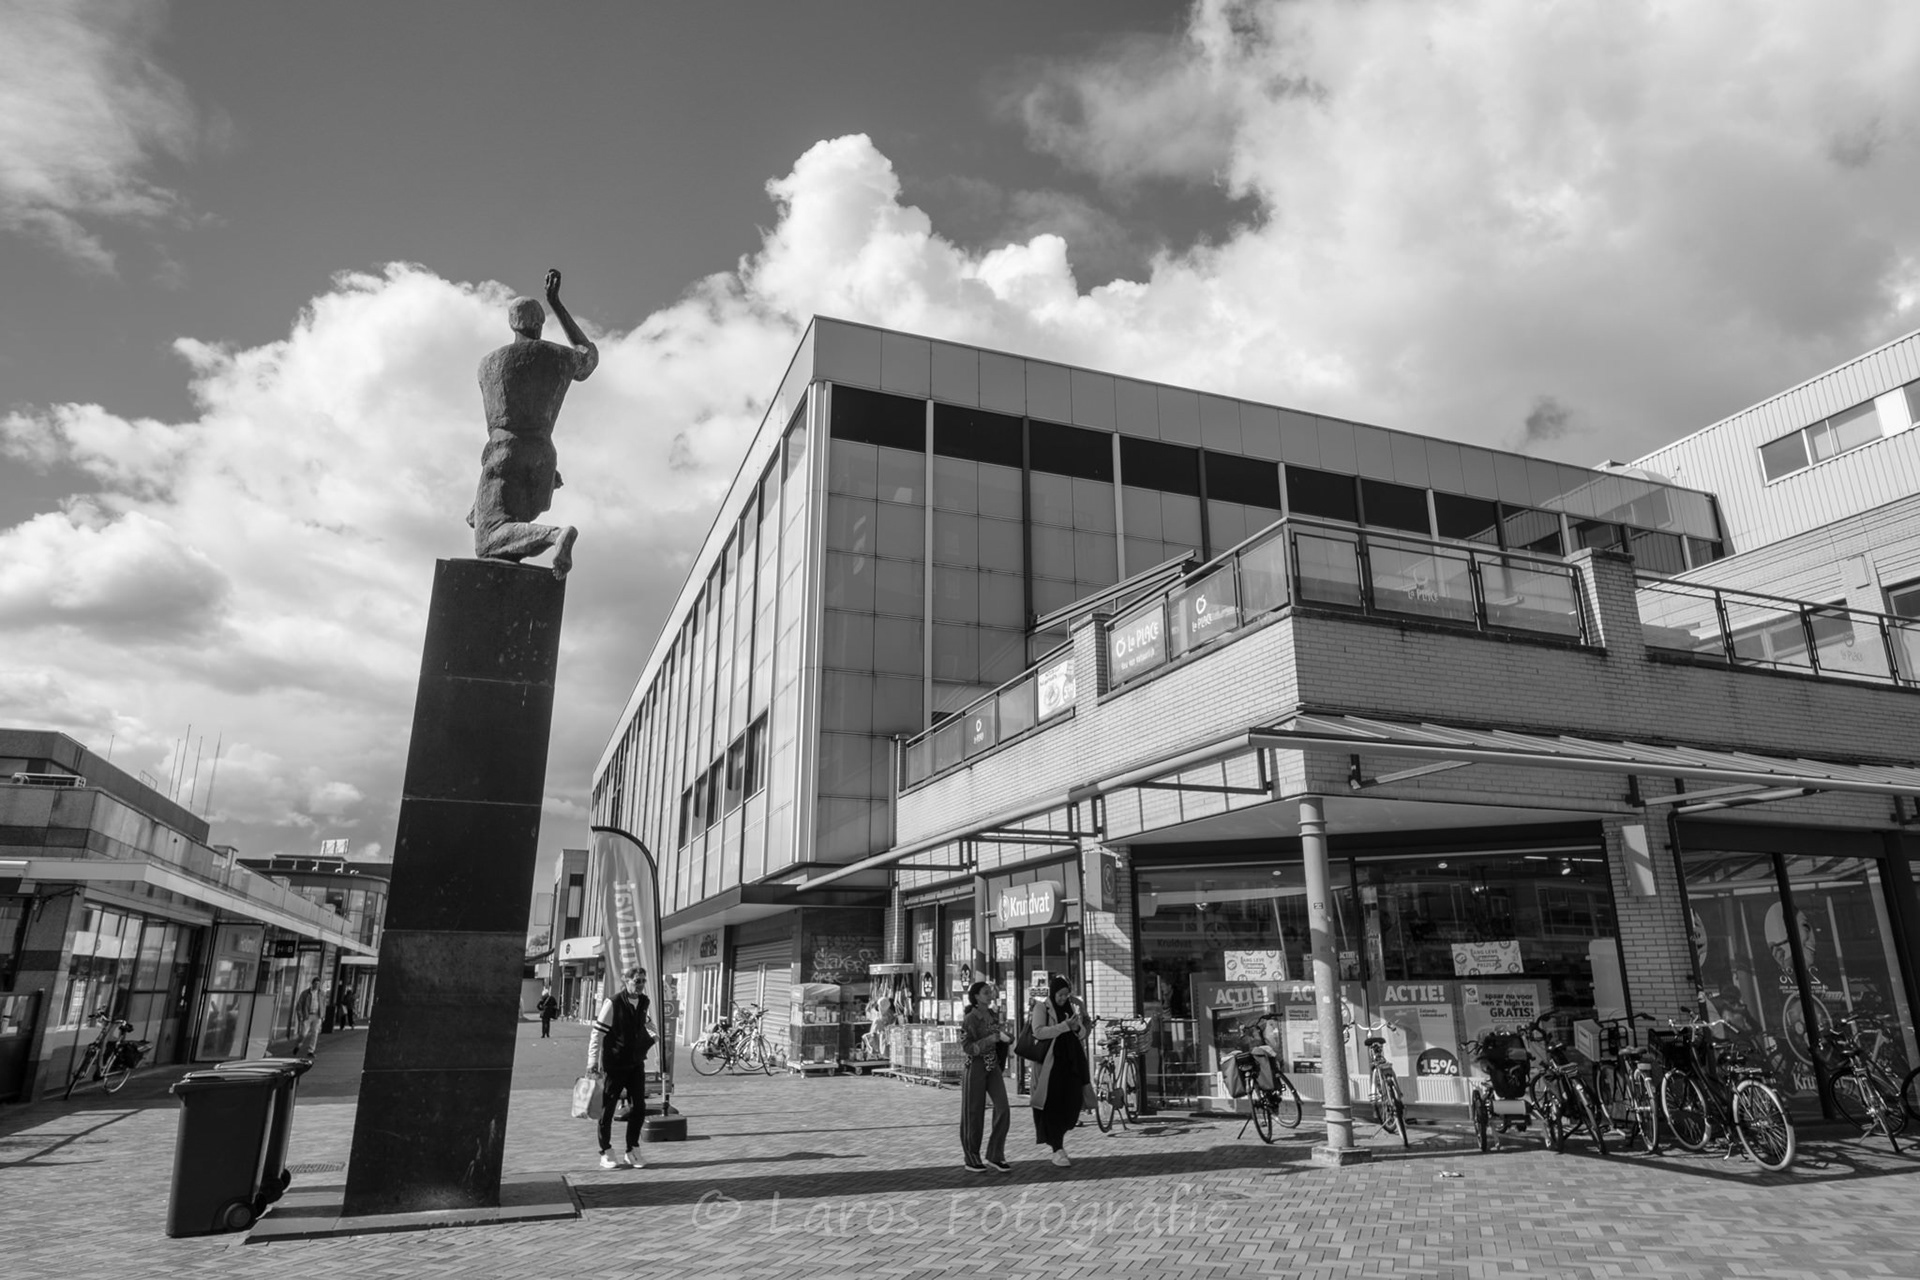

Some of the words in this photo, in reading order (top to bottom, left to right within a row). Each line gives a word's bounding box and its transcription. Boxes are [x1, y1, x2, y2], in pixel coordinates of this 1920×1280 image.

[1136, 621, 1160, 648] PLACE
[1010, 891, 1051, 918] Kruidvat
[1215, 986, 1269, 1005] ACTIE!
[1384, 984, 1446, 1003] ACTIE!
[1490, 1007, 1535, 1017] GRATIS!
[1420, 1059, 1458, 1074] 15%
